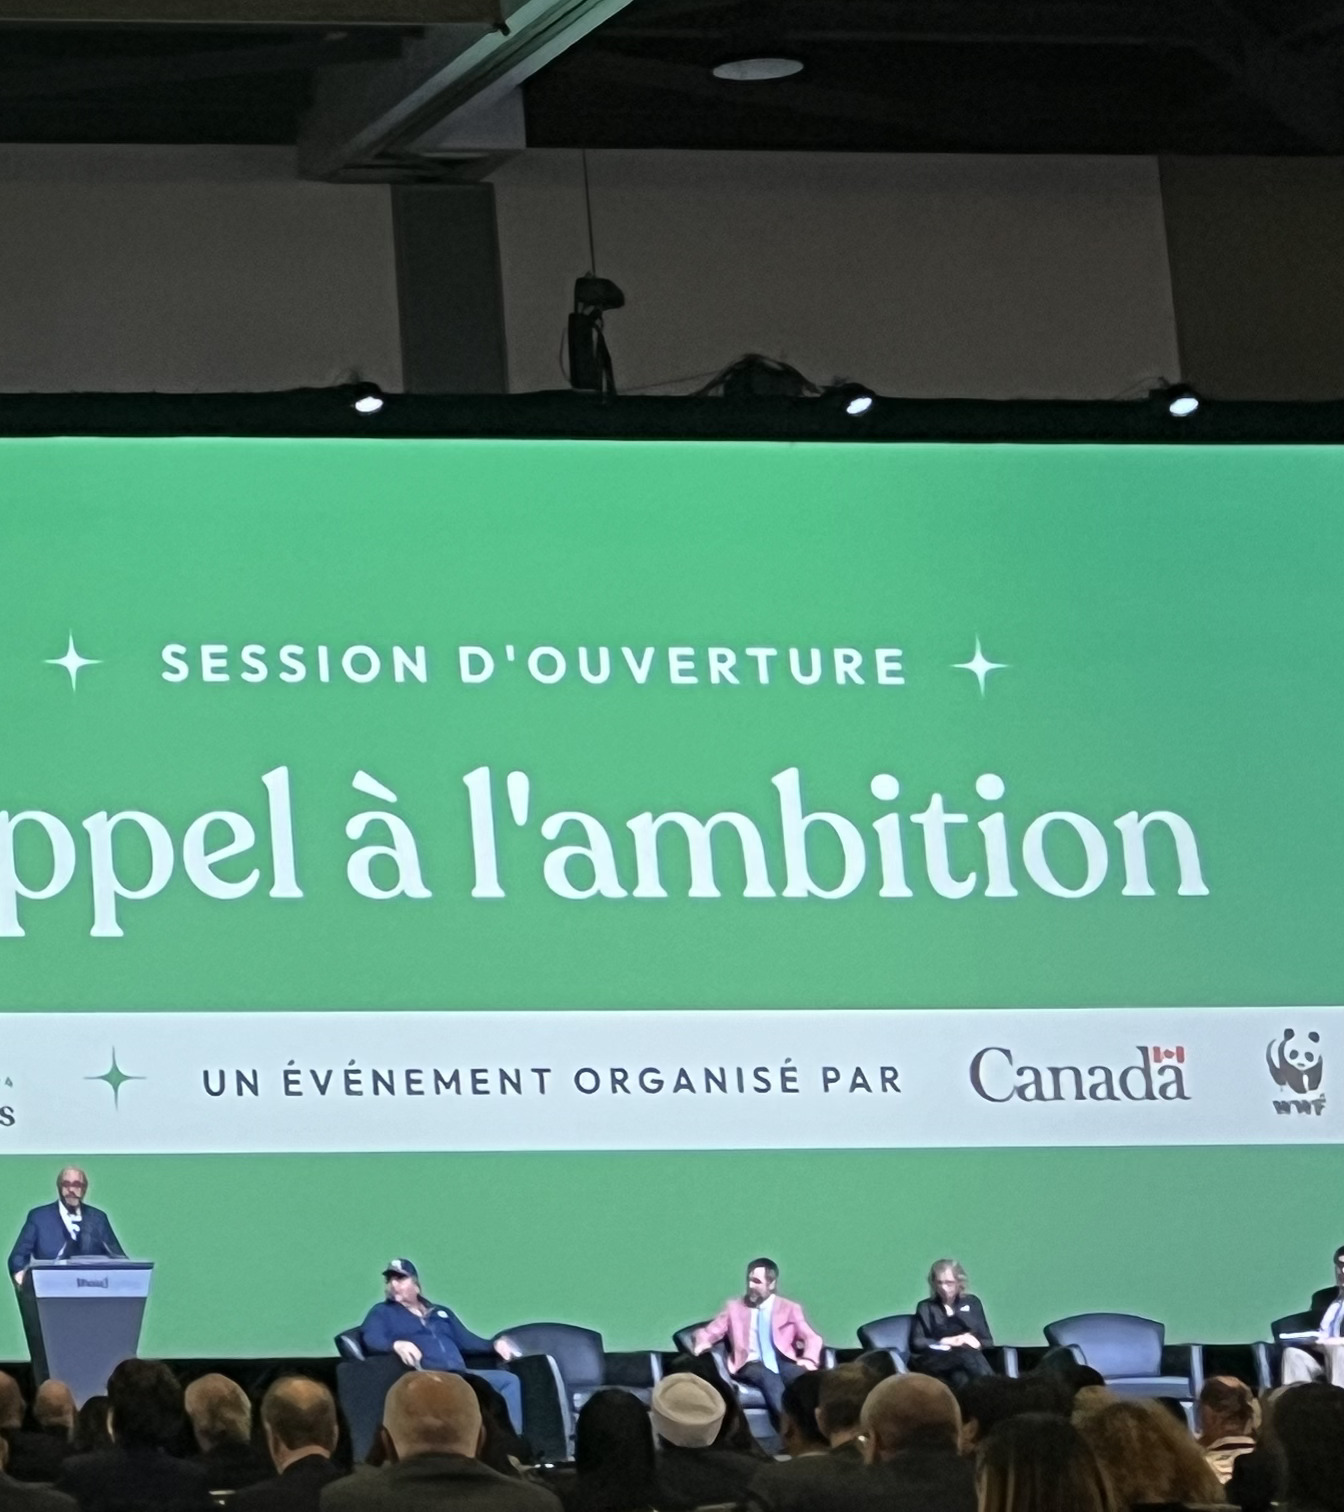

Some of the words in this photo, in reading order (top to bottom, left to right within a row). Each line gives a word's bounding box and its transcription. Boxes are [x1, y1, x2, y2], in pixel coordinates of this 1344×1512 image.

[161, 643, 429, 686] SESSION
[458, 644, 908, 688] D'OUVERTURE
[345, 770, 435, 902] à
[462, 764, 1213, 902] l'ambition
[202, 1069, 261, 1099] UN
[282, 1059, 554, 1099] ÉVÉNEMENT
[573, 1057, 802, 1097] ORGANISÉ
[821, 1065, 903, 1095] PAR
[969, 1045, 1193, 1104] Canada
